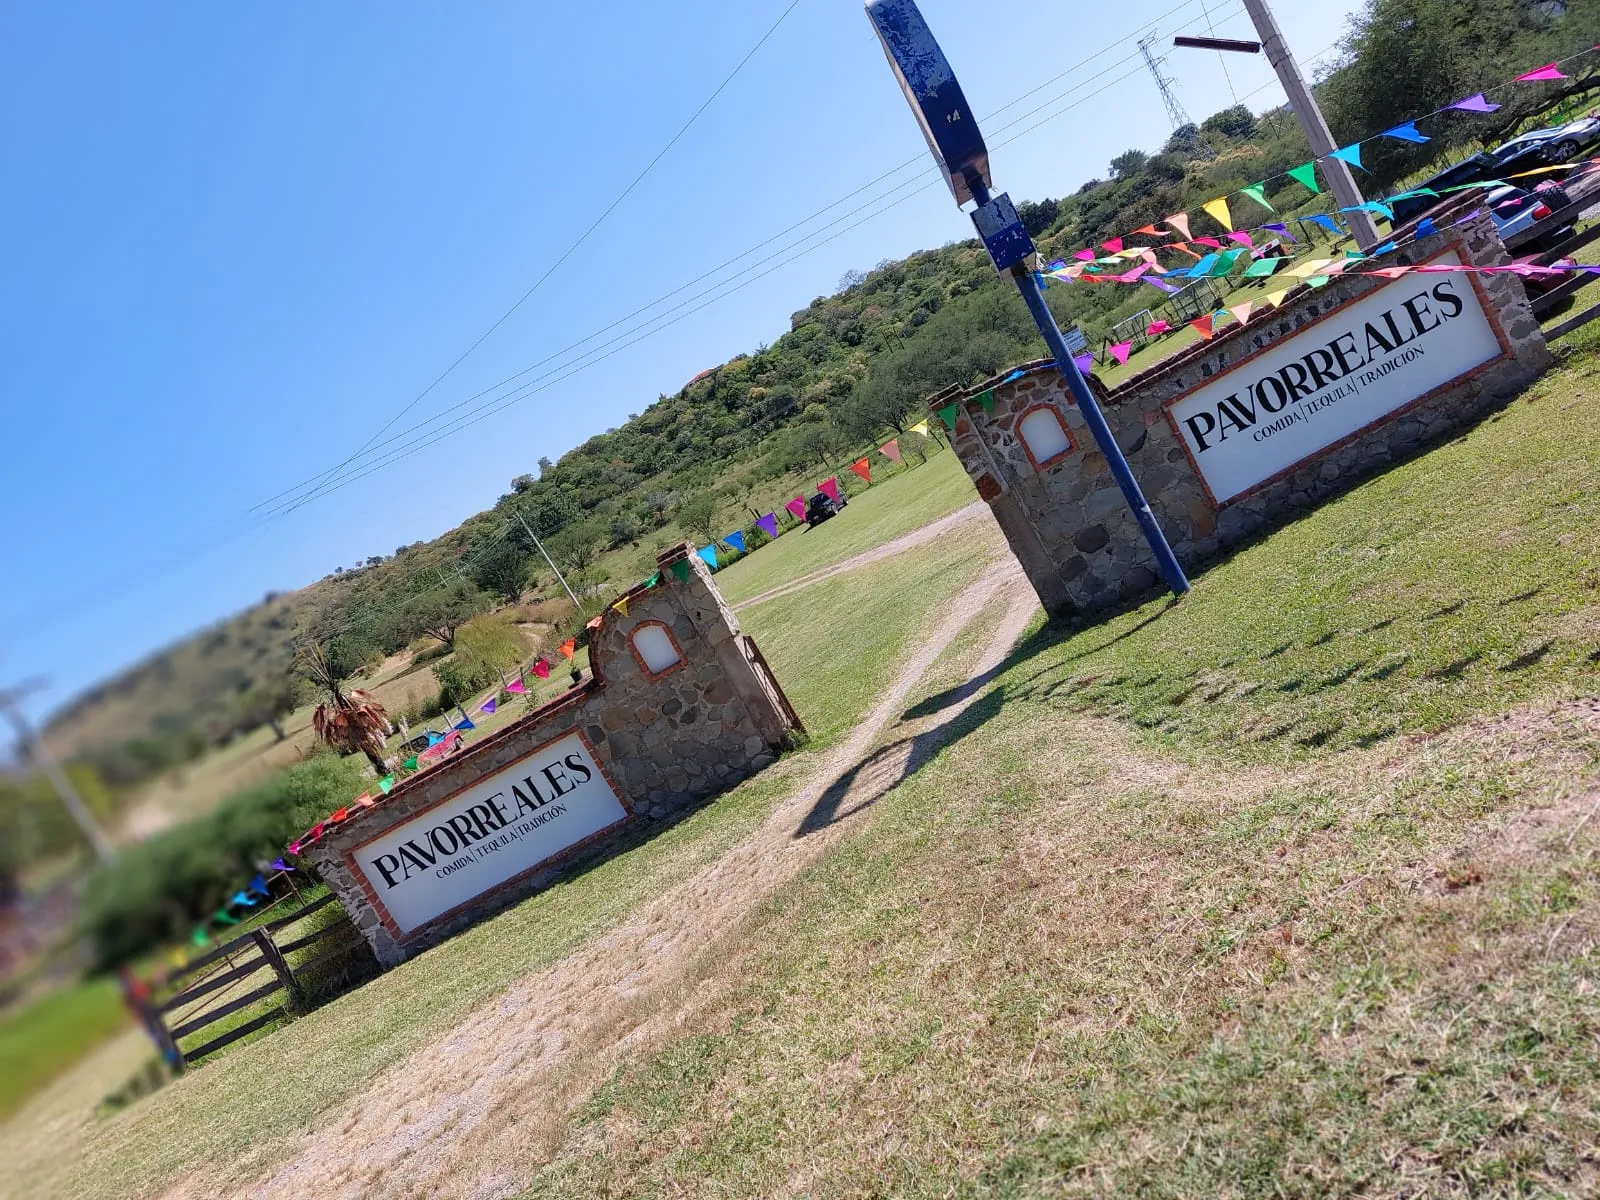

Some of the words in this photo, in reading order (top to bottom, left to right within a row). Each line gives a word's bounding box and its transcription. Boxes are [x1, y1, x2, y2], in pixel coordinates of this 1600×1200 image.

[1182, 279, 1463, 453] PAVORREALES
[1253, 411, 1302, 442] COMIDA
[1304, 383, 1355, 415] TEQUILA
[1357, 344, 1425, 387] TRADICIÓN
[371, 752, 592, 889] PAVORREALES
[436, 855, 474, 878] COMIDA
[476, 831, 518, 857] TEQUILA
[517, 803, 567, 835] TRADICIÓN
